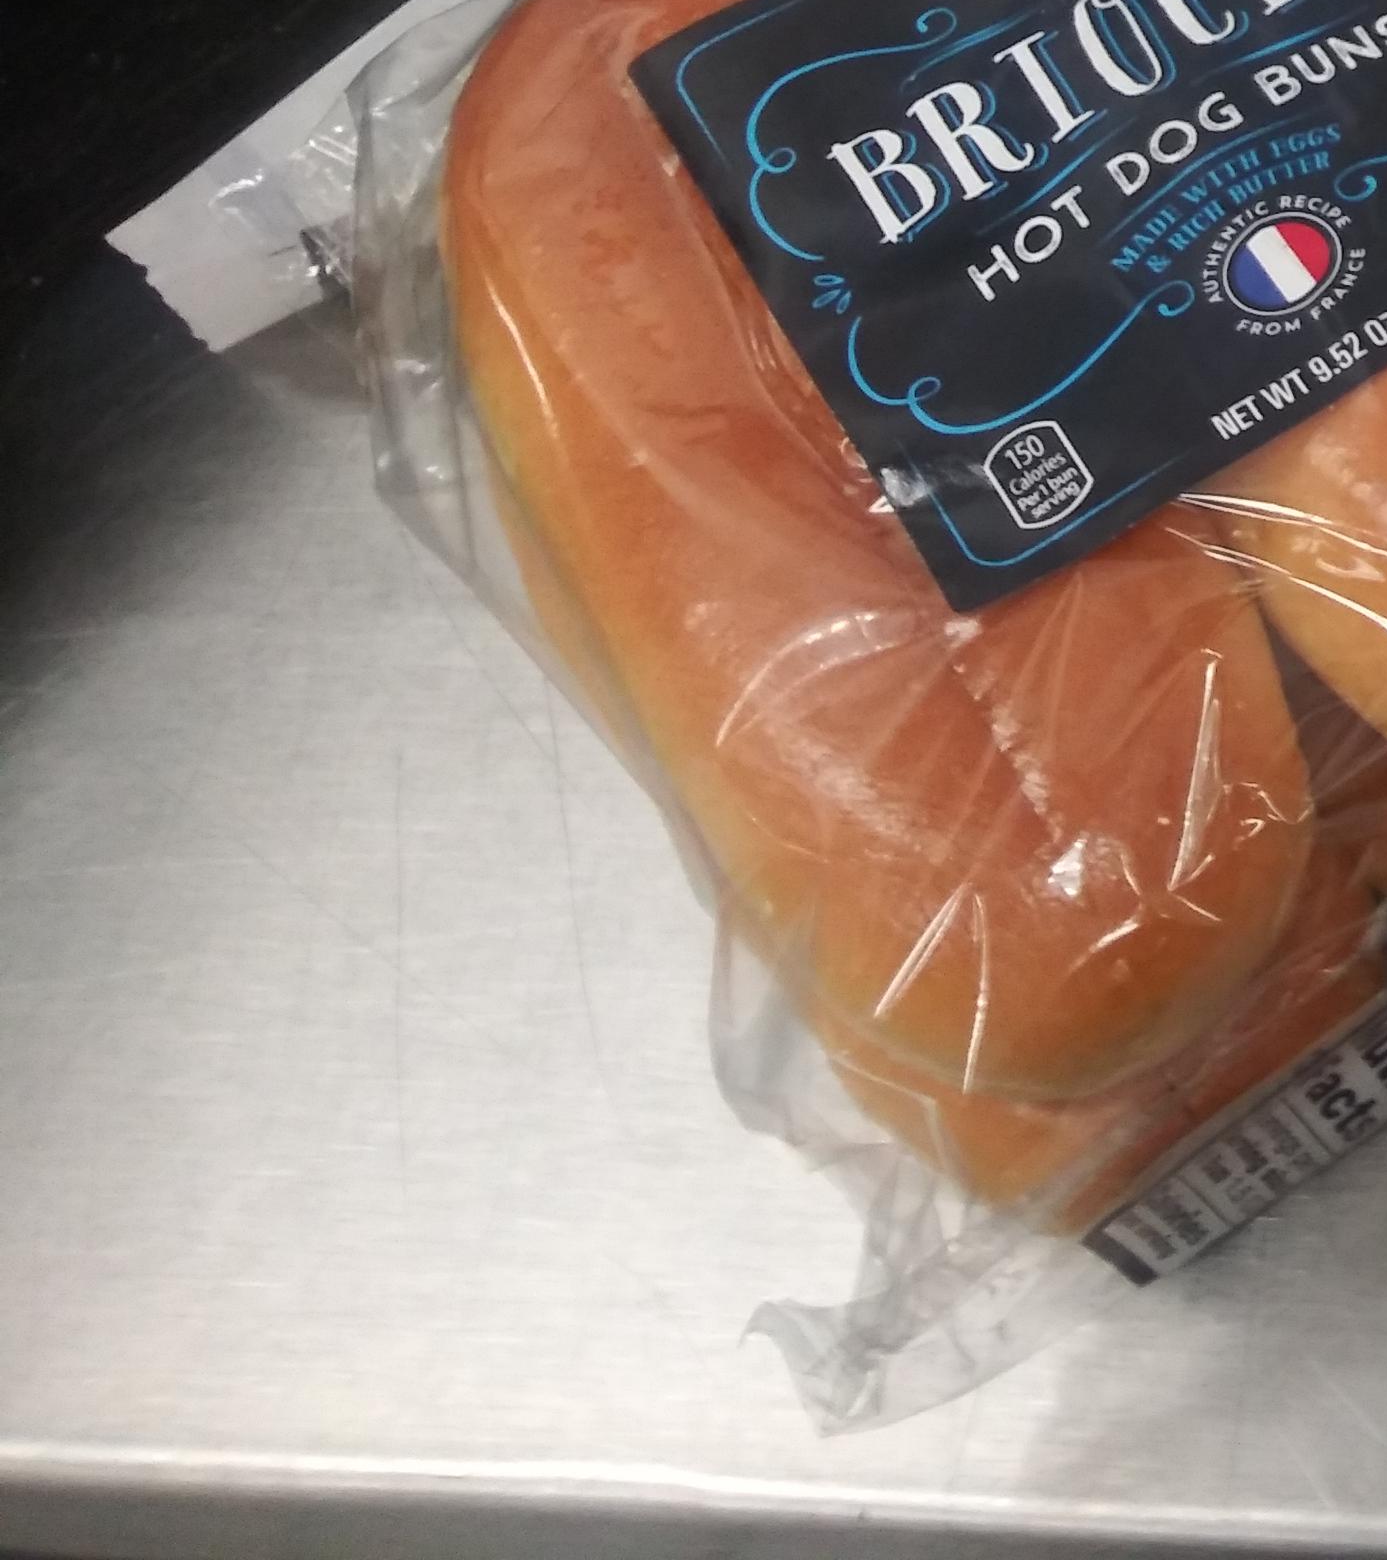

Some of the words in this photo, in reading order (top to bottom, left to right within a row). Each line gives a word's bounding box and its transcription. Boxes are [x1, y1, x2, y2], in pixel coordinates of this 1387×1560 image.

[966, 185, 1091, 301] HOT
[1105, 91, 1244, 196] DOG
[1111, 206, 1178, 273] MADE
[1180, 148, 1261, 204] WITH
[1268, 123, 1341, 158] EGGS
[1146, 254, 1172, 274] &
[1167, 199, 1227, 251] RICH
[1227, 150, 1331, 205] BUTTER
[1201, 200, 1270, 303] AUTHENTIC
[1279, 194, 1352, 230] RECIPE
[1235, 317, 1302, 337] FROM
[1309, 247, 1367, 320] FRANCE
[1210, 394, 1264, 441] NET
[1259, 367, 1311, 411] WT
[1307, 331, 1369, 384] 9.52
[1004, 434, 1045, 470] 150
[1009, 452, 1068, 495] Calories
